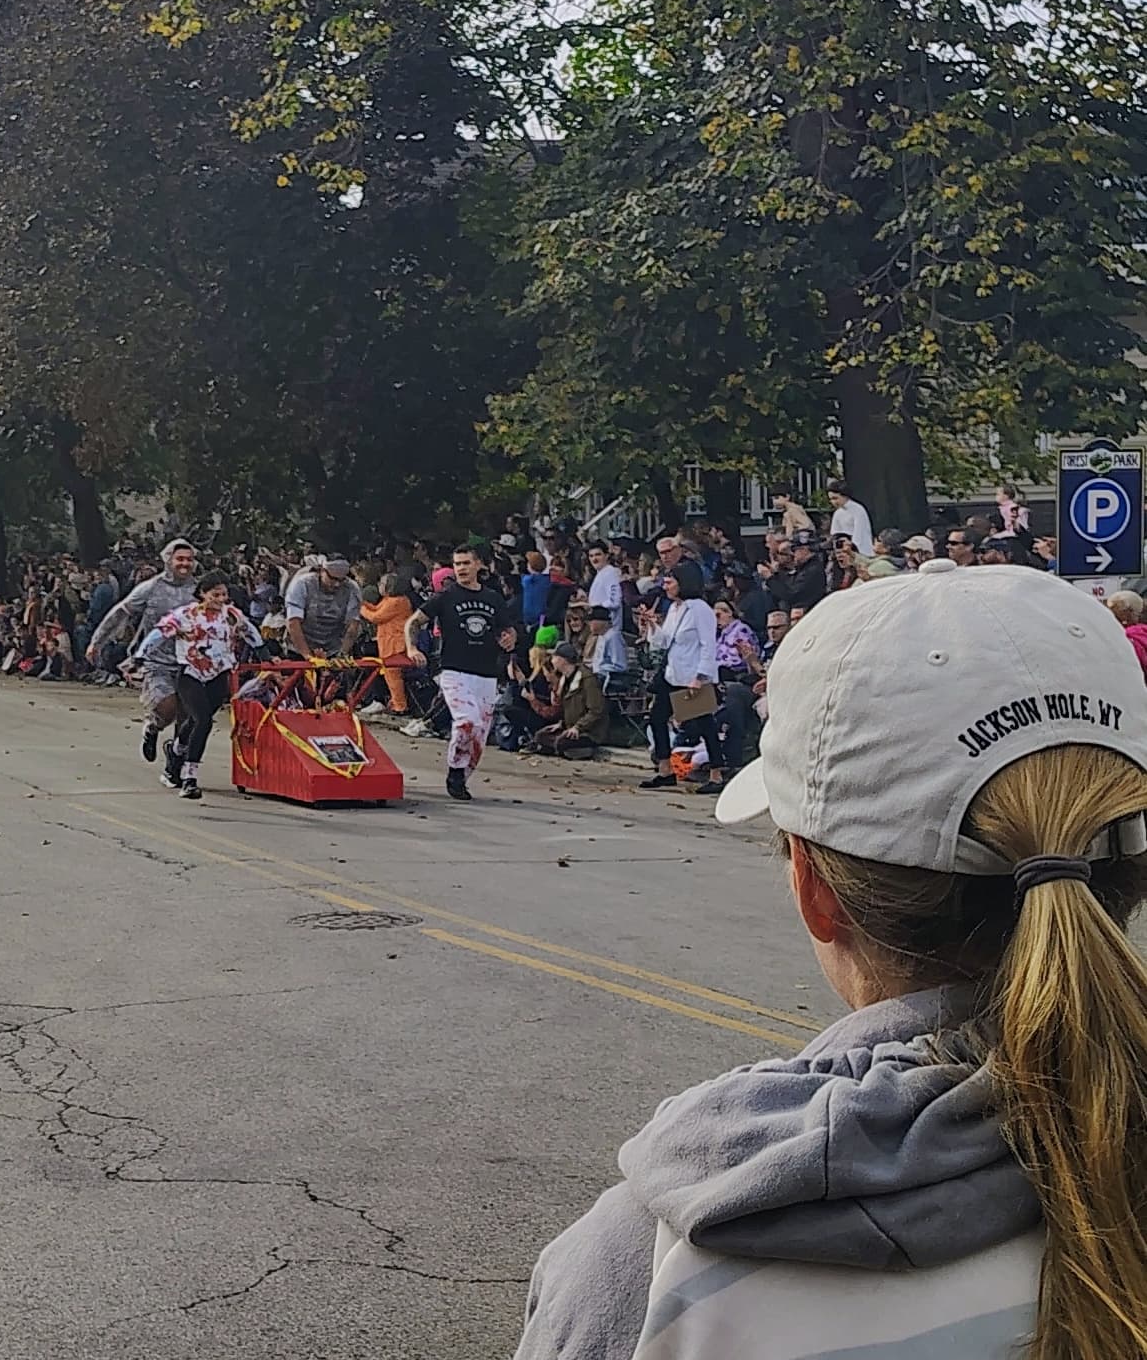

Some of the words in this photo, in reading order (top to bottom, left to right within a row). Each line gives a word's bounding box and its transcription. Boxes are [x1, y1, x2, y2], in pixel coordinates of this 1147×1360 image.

[1063, 454, 1088, 468] FOREST
[1113, 453, 1139, 467] PARK
[1087, 489, 1120, 534] P
[1092, 586, 1105, 597] NO
[957, 696, 1043, 758] JACKSON
[1043, 693, 1096, 724] HOLE,
[1097, 698, 1123, 731] WY
